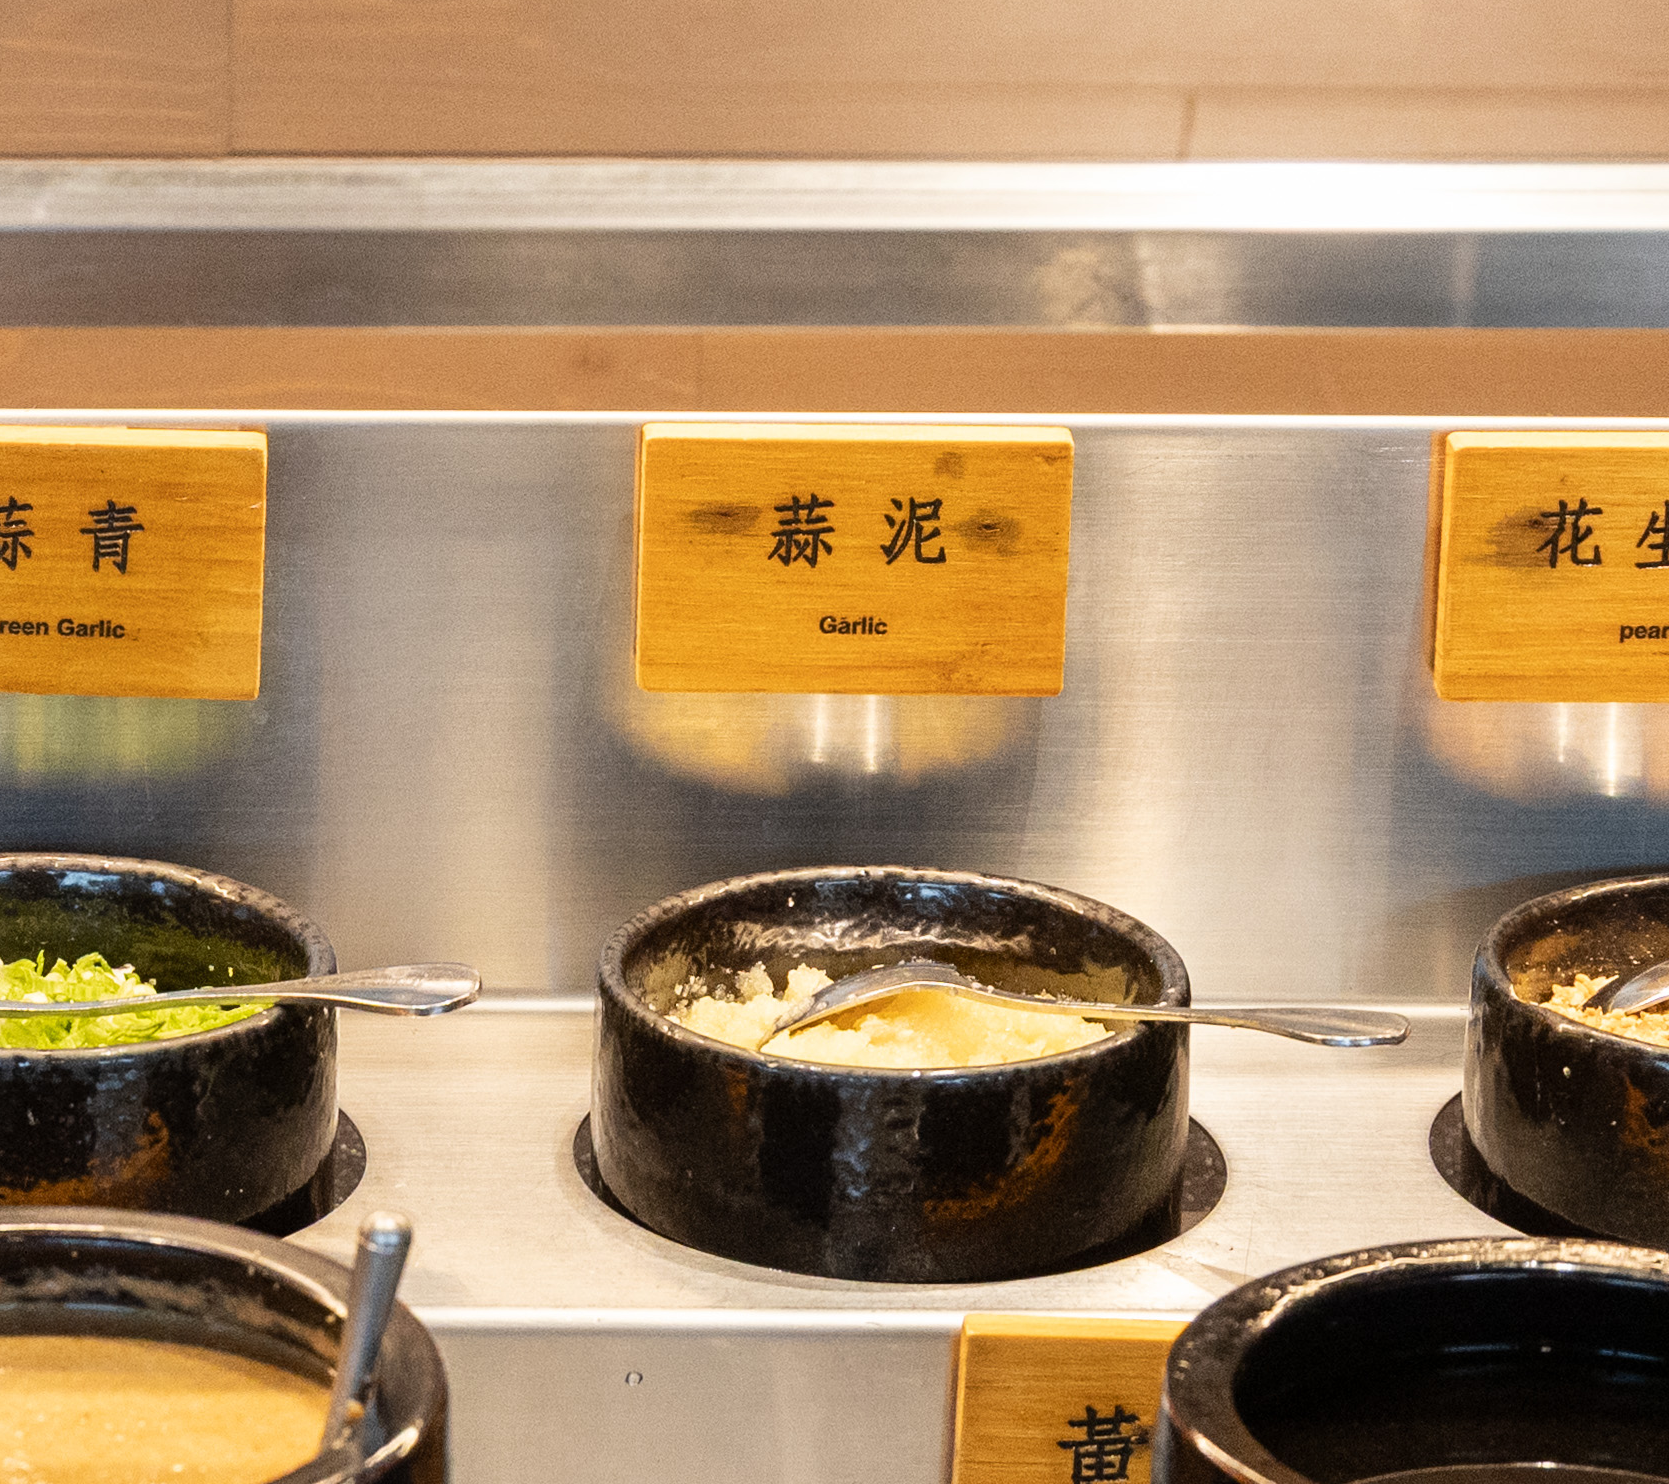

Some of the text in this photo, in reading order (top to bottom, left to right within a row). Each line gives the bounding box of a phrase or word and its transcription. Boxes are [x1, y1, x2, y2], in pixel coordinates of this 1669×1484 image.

[767, 492, 948, 569] 蒜泥
[57, 617, 125, 640] Garlic
[819, 614, 887, 636] Garlic
